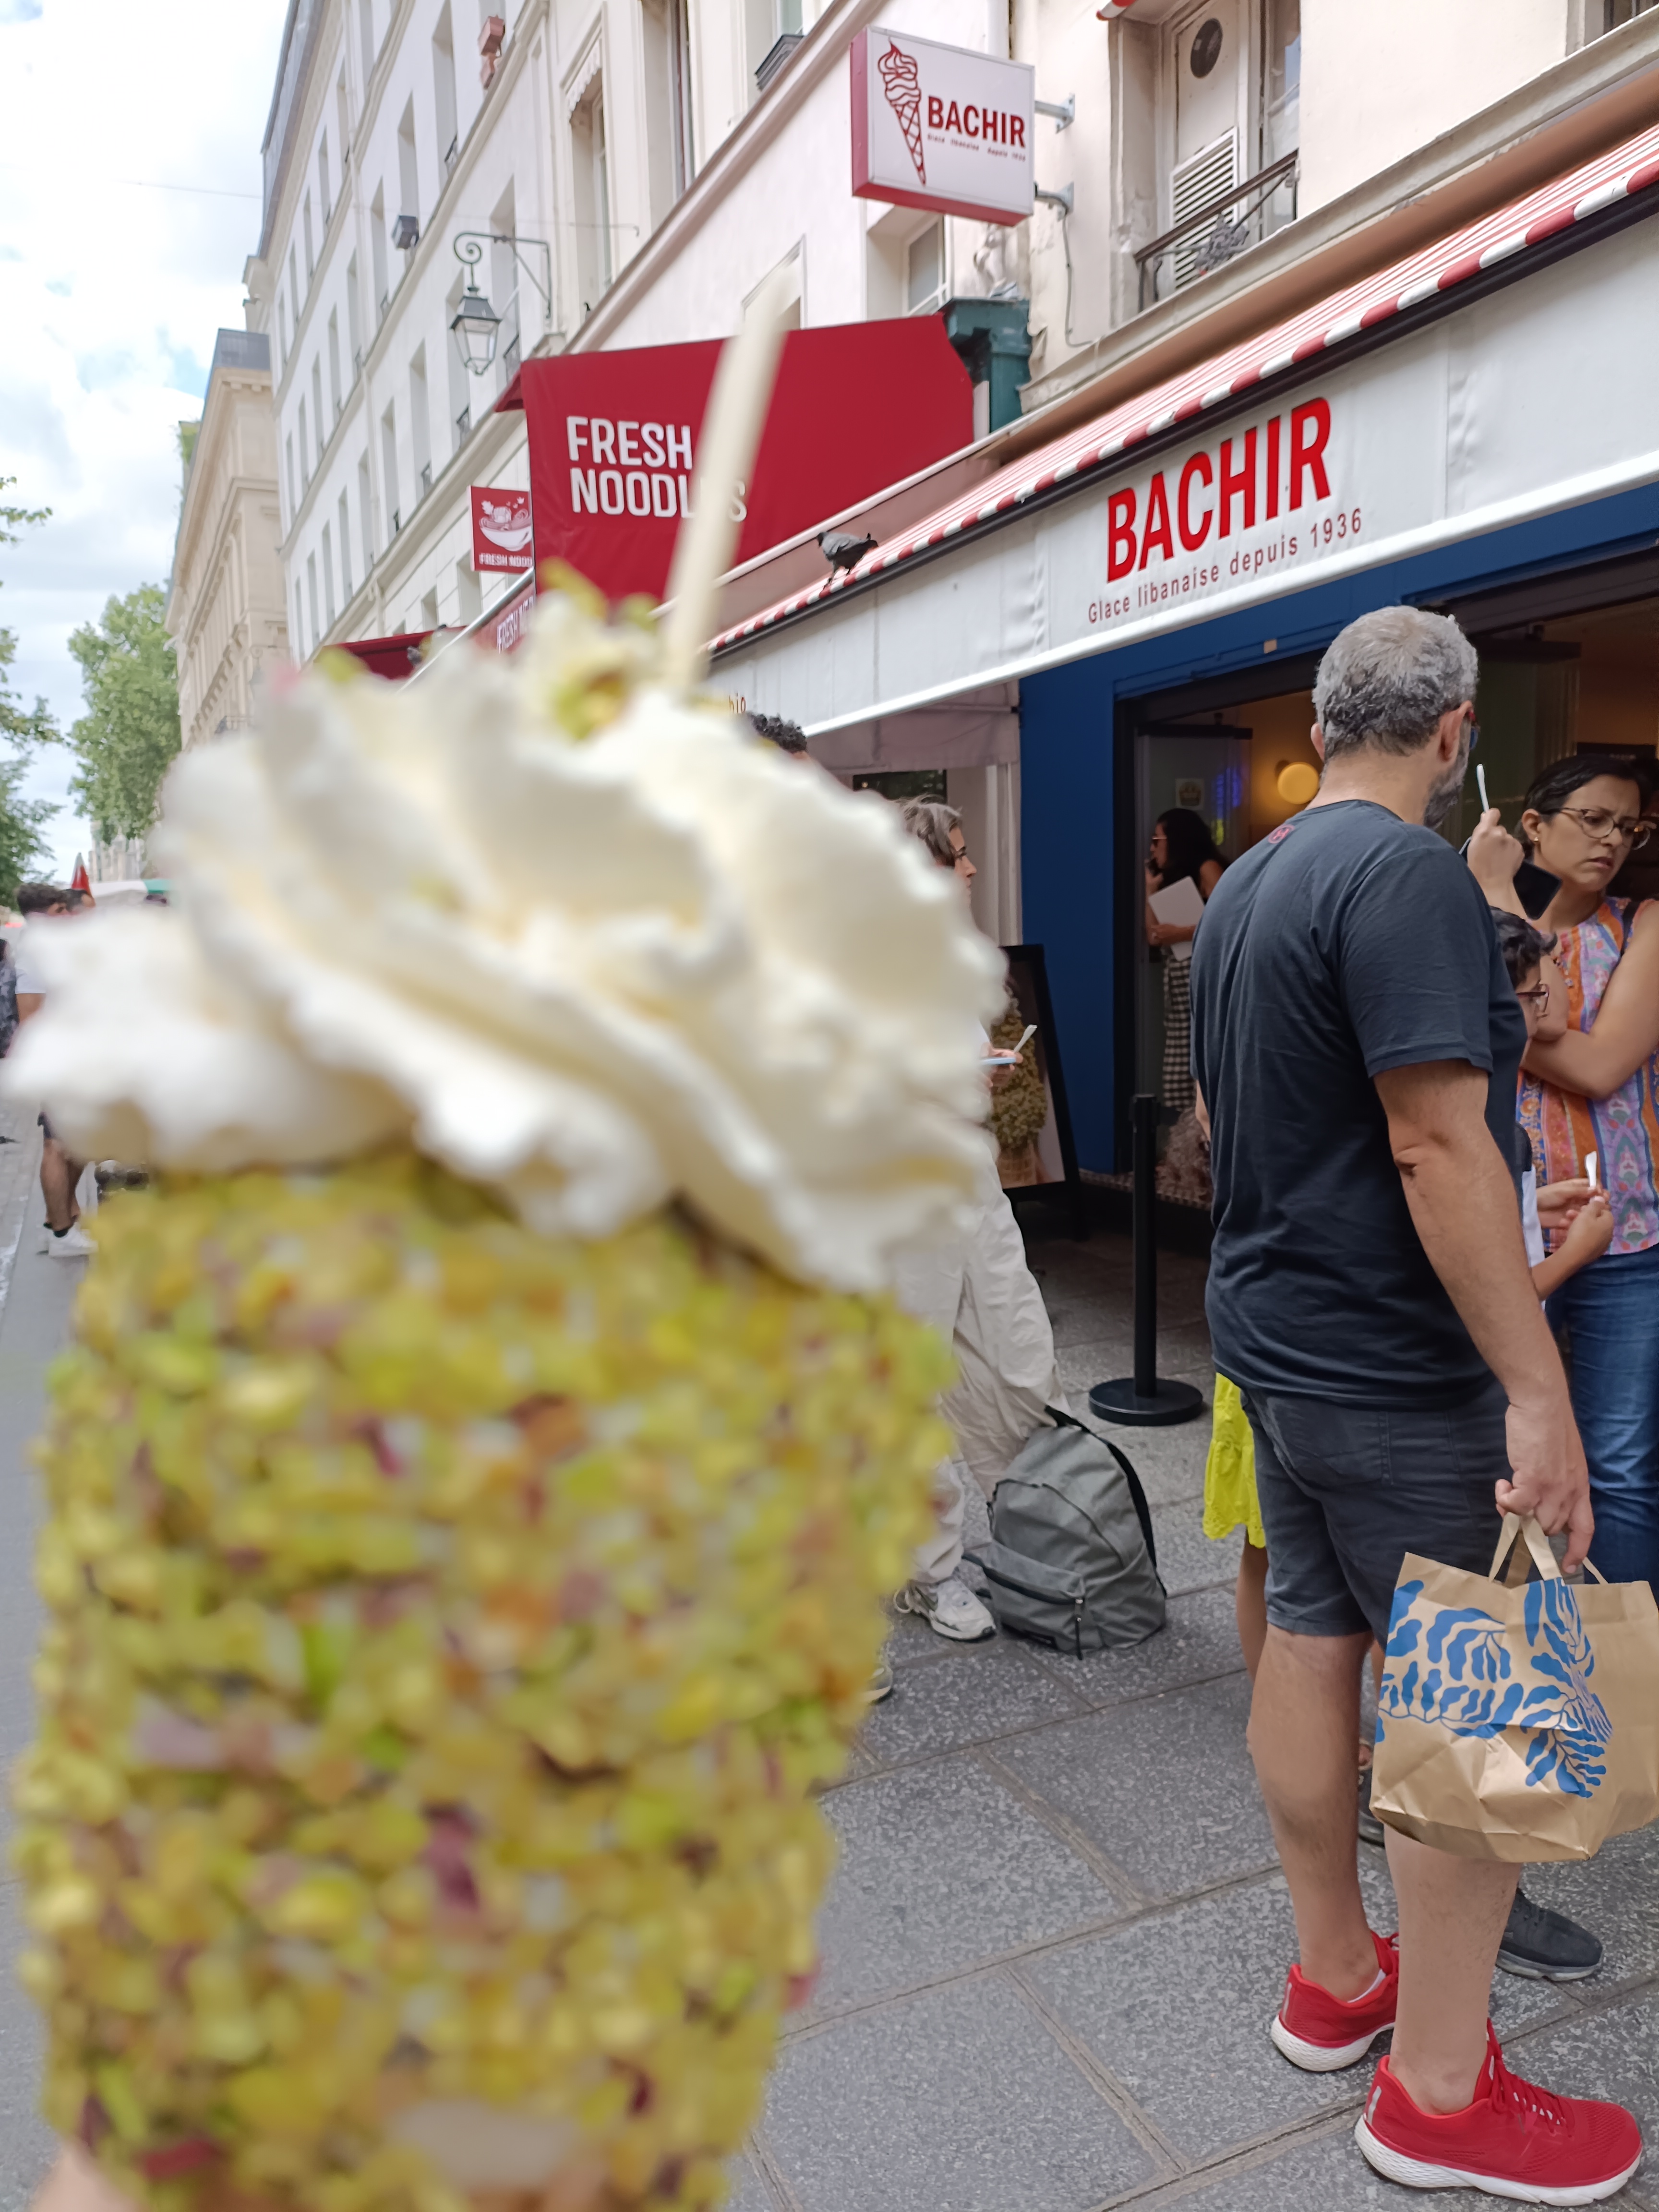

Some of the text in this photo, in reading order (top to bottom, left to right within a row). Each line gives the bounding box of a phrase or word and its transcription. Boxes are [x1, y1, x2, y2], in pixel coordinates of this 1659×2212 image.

[928, 96, 1026, 148] BACHIR
[566, 416, 693, 470] FRESH
[570, 467, 747, 522] NOODLS
[1106, 397, 1331, 584] BACHIR
[479, 553, 508, 566] FRESH
[1088, 507, 1362, 624] Glace libanaise depuis 1936
